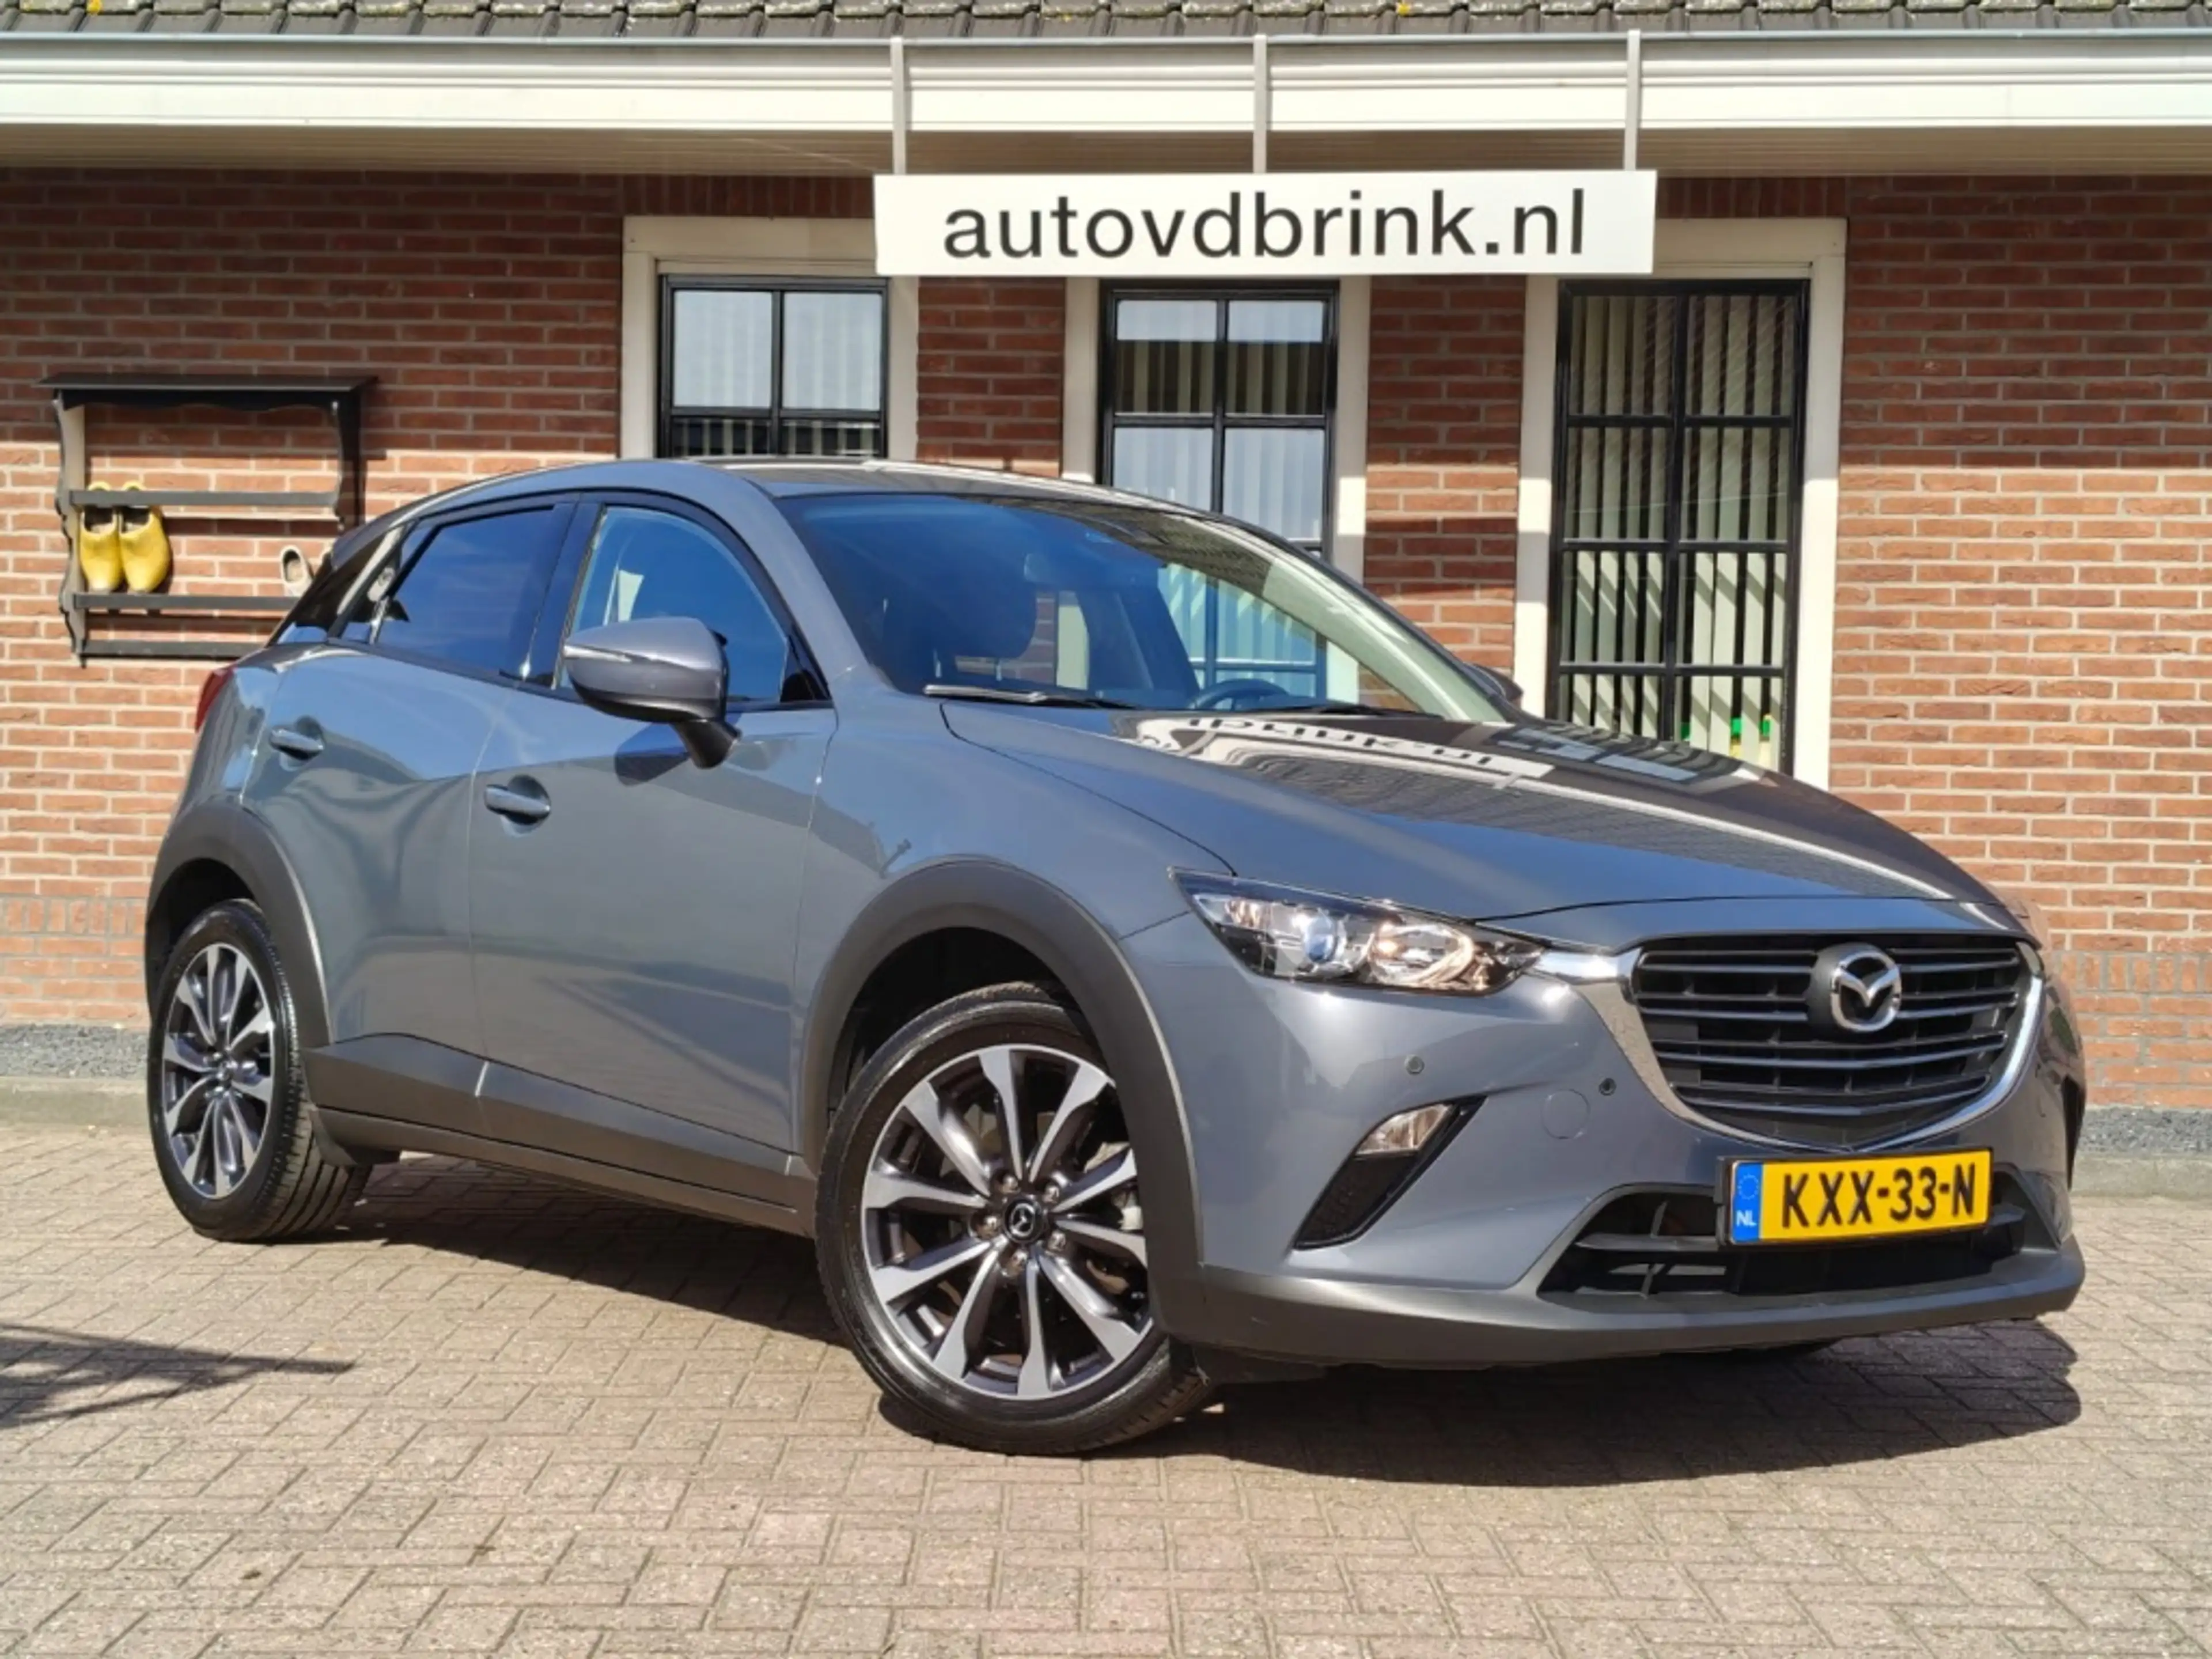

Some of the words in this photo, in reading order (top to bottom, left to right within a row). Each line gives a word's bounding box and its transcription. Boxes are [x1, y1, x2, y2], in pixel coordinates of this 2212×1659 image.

[944, 188, 1584, 258] autovdbrink.nl
[1736, 1210, 1757, 1226] NL
[1782, 1164, 1975, 1228] KXX-33-N
